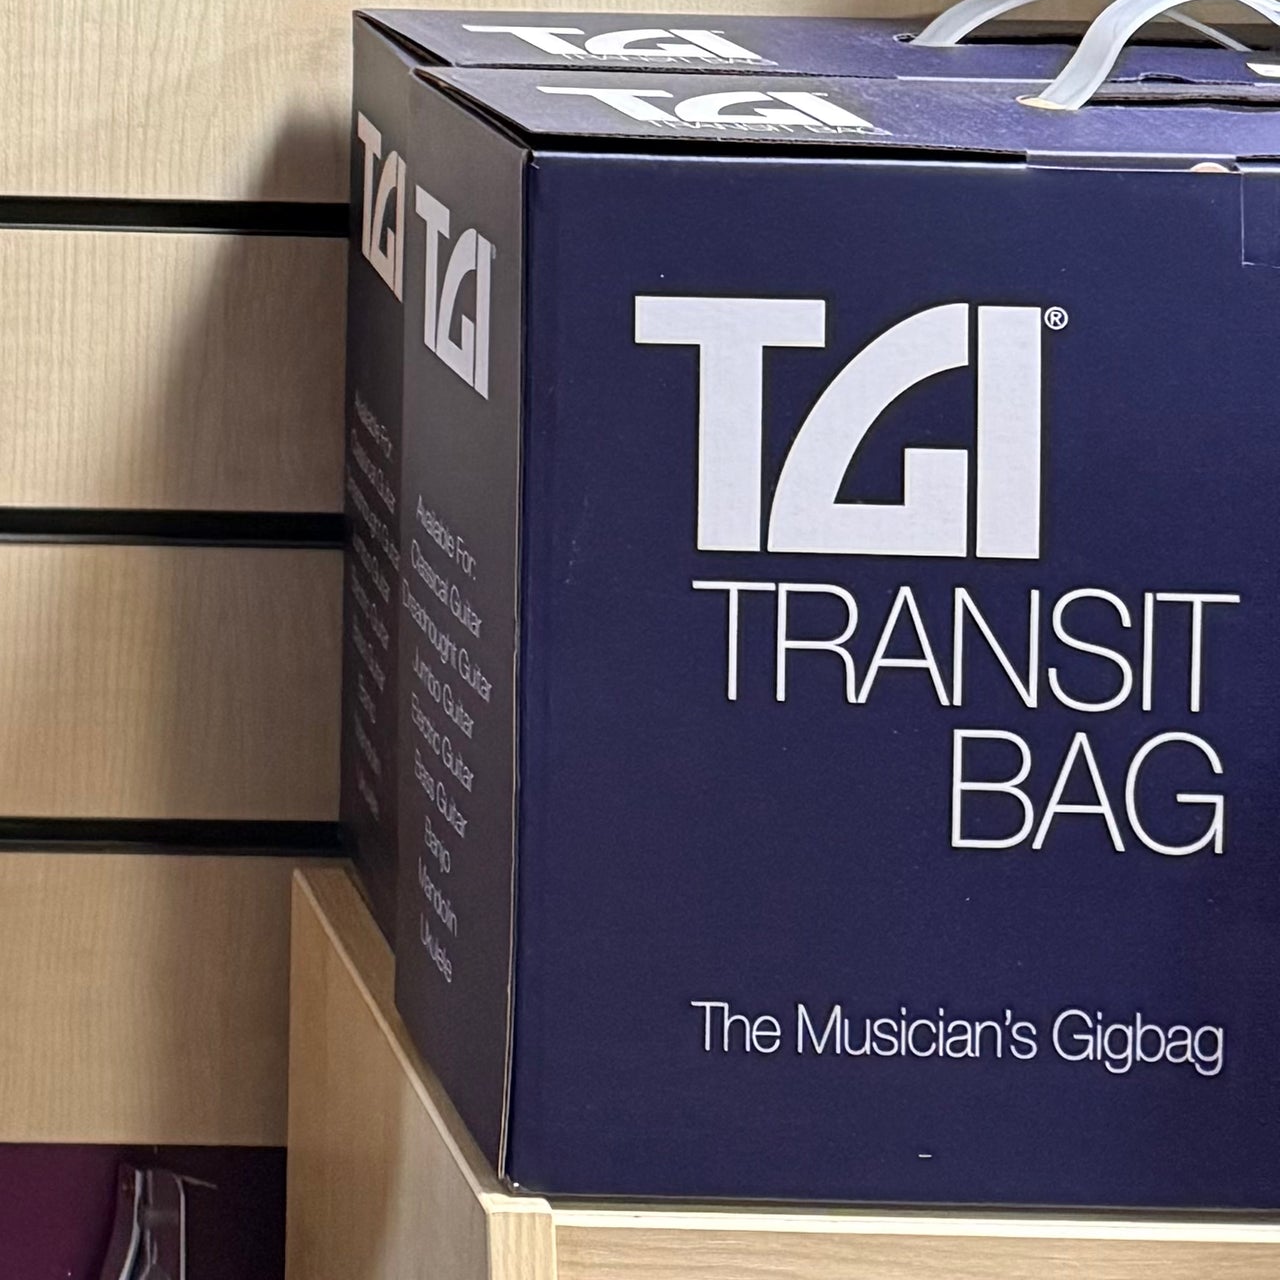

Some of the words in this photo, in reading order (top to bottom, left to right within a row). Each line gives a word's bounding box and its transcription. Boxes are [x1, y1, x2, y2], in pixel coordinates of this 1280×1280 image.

[462, 24, 762, 60] TGI
[536, 86, 875, 128] TGI
[358, 111, 406, 303] TGI
[416, 184, 490, 400] TGI
[450, 584, 482, 638] Guitar
[692, 580, 1240, 712] TRANSIT
[458, 648, 492, 703] Guitar
[442, 683, 474, 739] Guitar
[442, 736, 474, 792] Guitar
[952, 729, 1225, 855] BAG
[436, 782, 468, 838] Guitar
[691, 1001, 781, 1056] The
[798, 1003, 1039, 1062] Musician's
[1053, 1008, 1225, 1076] Gigbag
